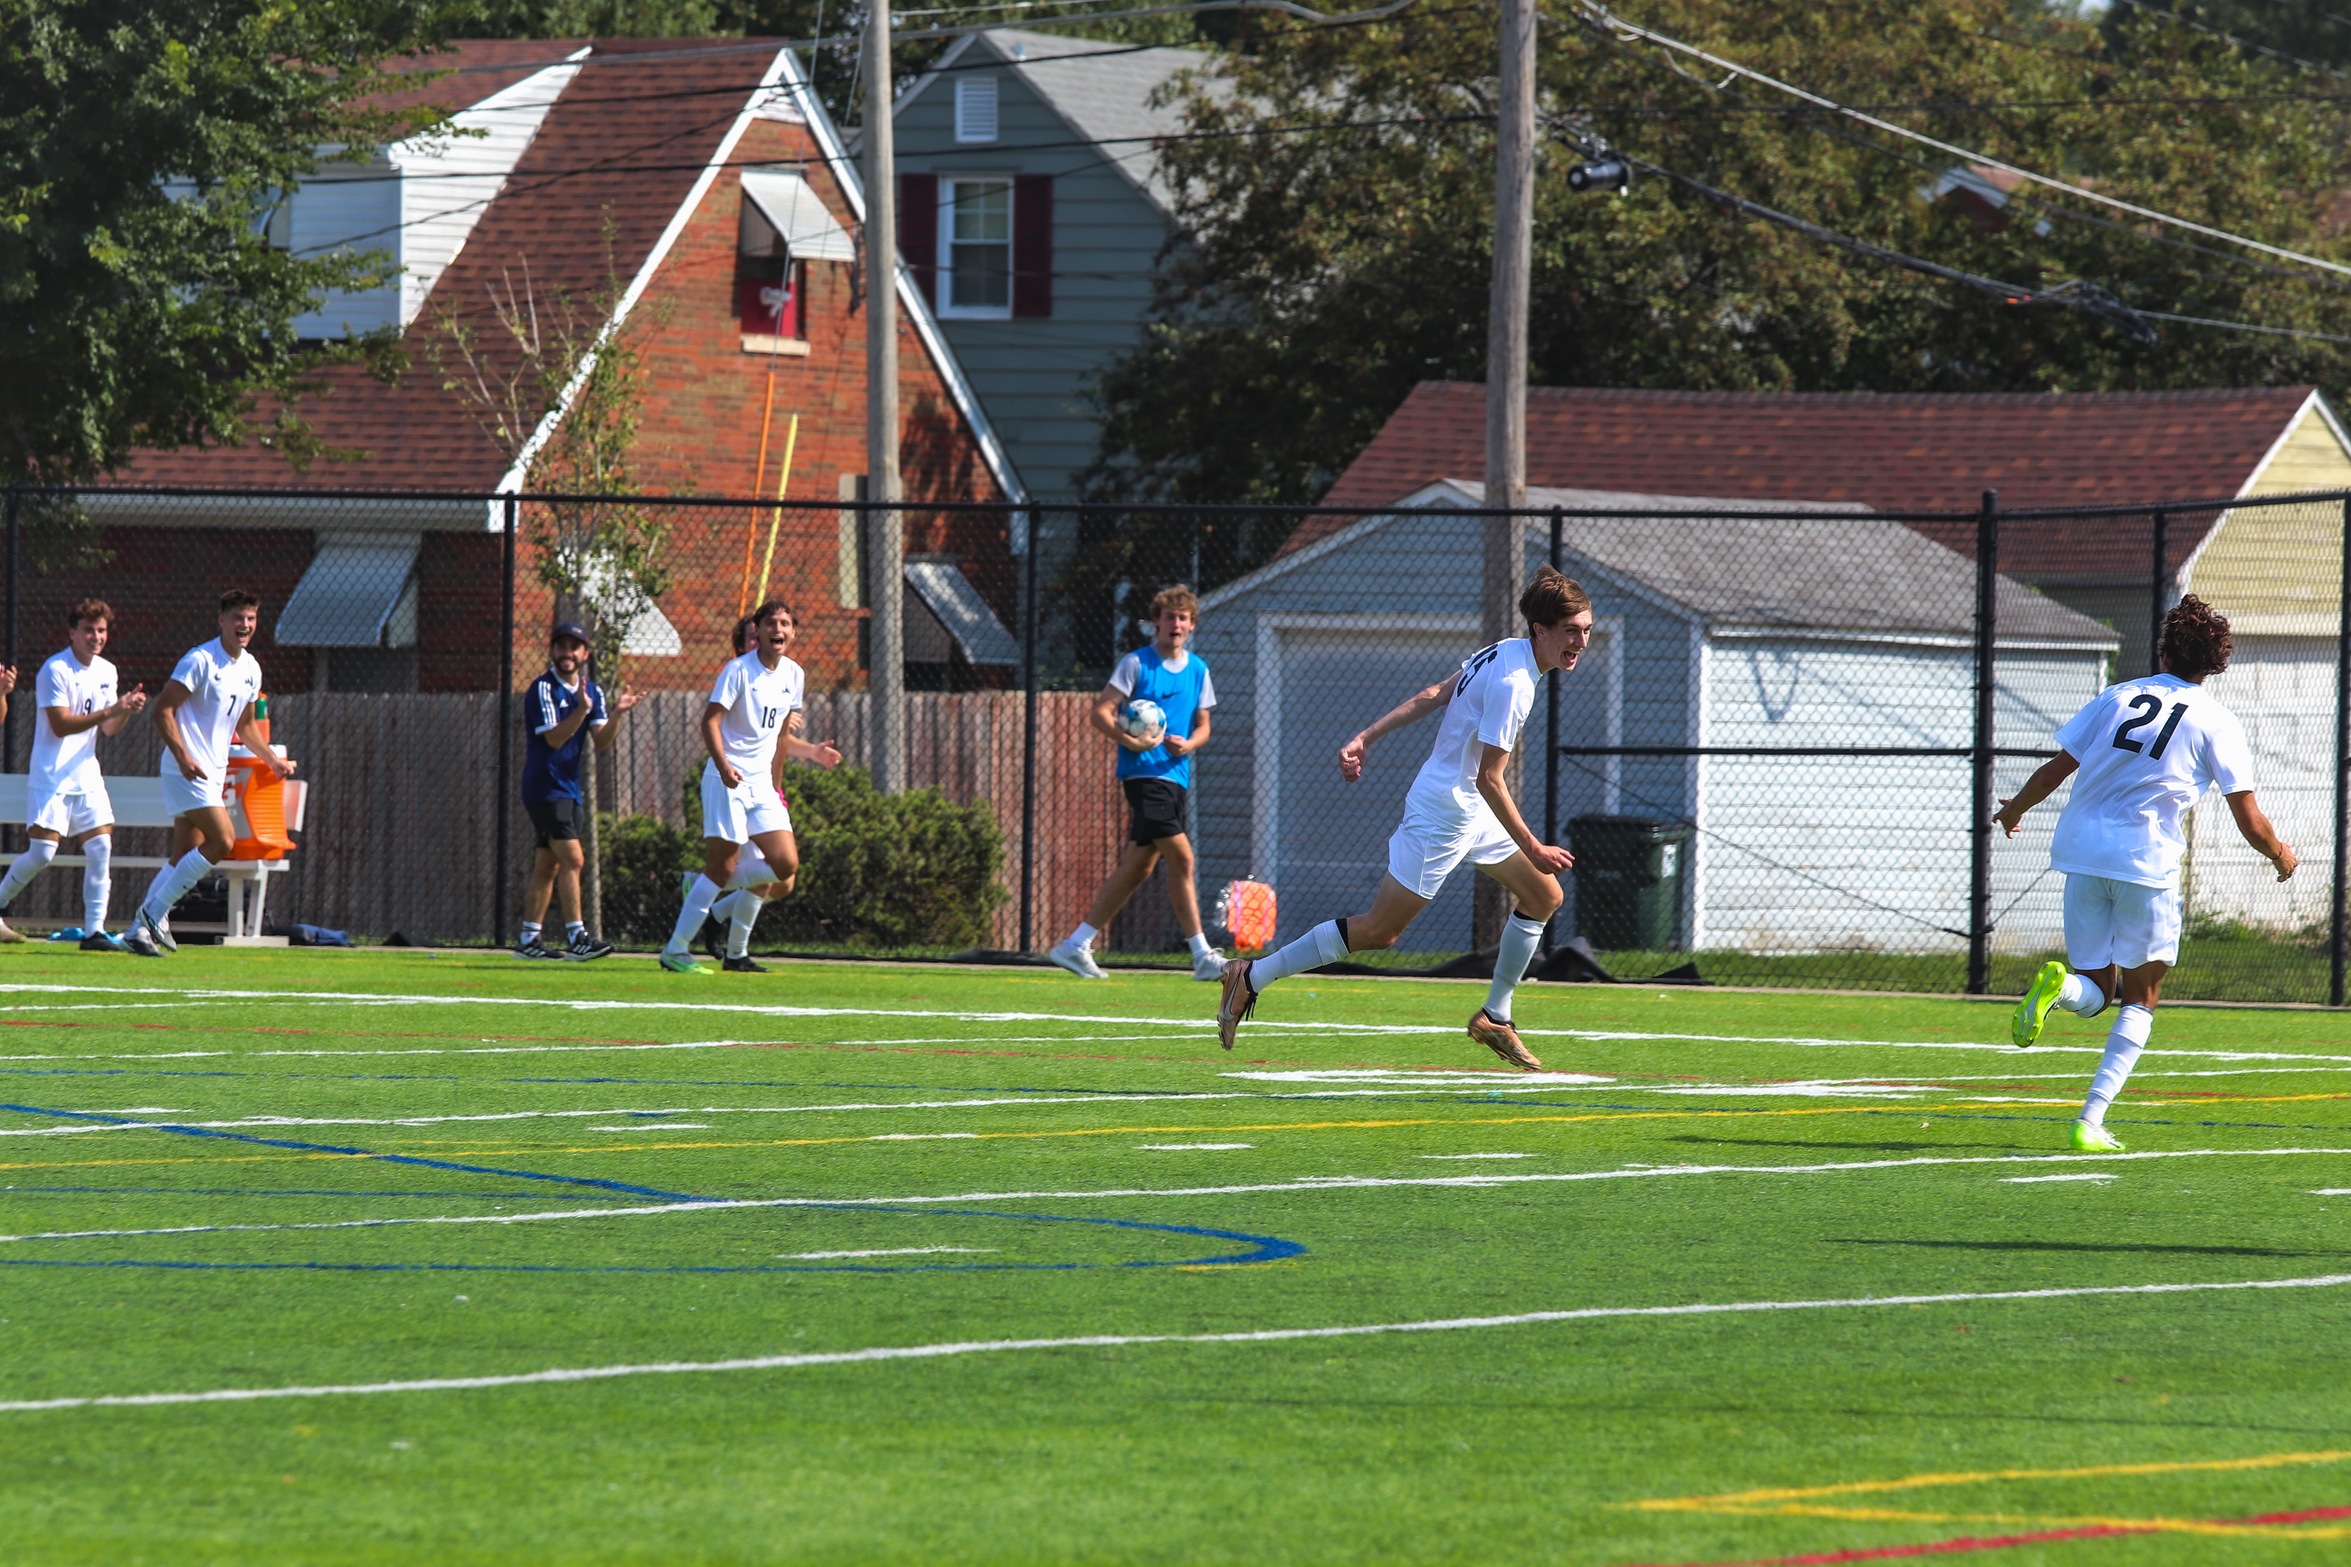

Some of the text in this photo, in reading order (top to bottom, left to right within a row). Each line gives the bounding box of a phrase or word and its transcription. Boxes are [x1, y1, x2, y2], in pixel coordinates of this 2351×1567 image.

[83, 698, 92, 715] 9
[227, 694, 236, 716] 7
[761, 706, 777, 728] 18
[2112, 694, 2189, 761] 21
